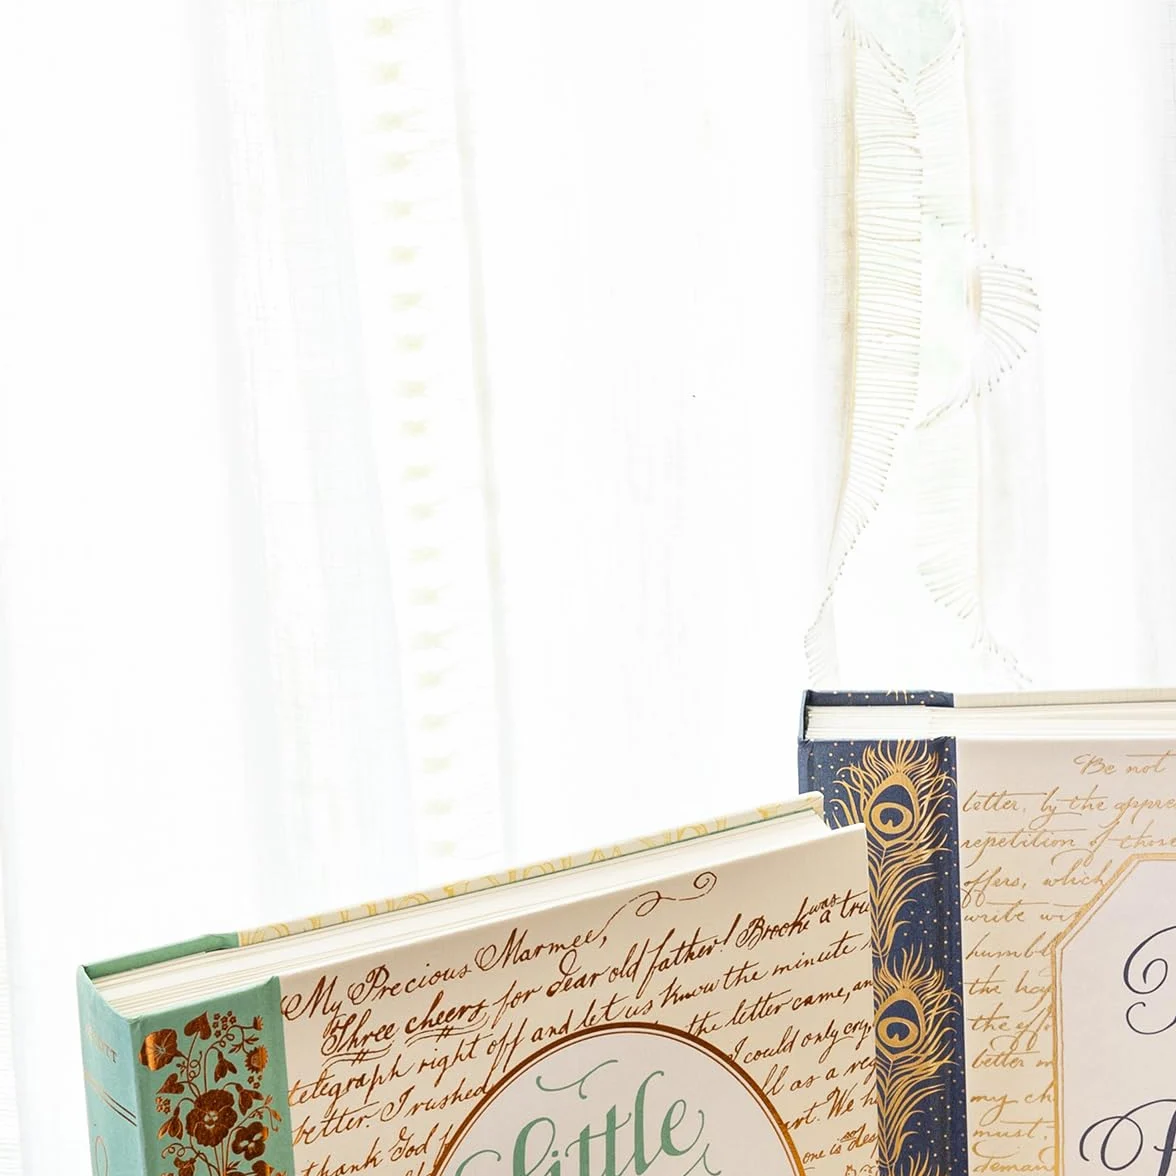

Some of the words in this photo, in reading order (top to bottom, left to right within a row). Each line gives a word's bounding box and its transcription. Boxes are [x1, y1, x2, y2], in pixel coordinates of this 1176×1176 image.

[280, 975, 342, 1021] My
[348, 963, 472, 1006] Precious
[320, 1009, 400, 1056] Three
[404, 990, 490, 1035] cheers
[487, 980, 543, 1030] for
[546, 949, 610, 998] dear
[609, 939, 650, 983] old
